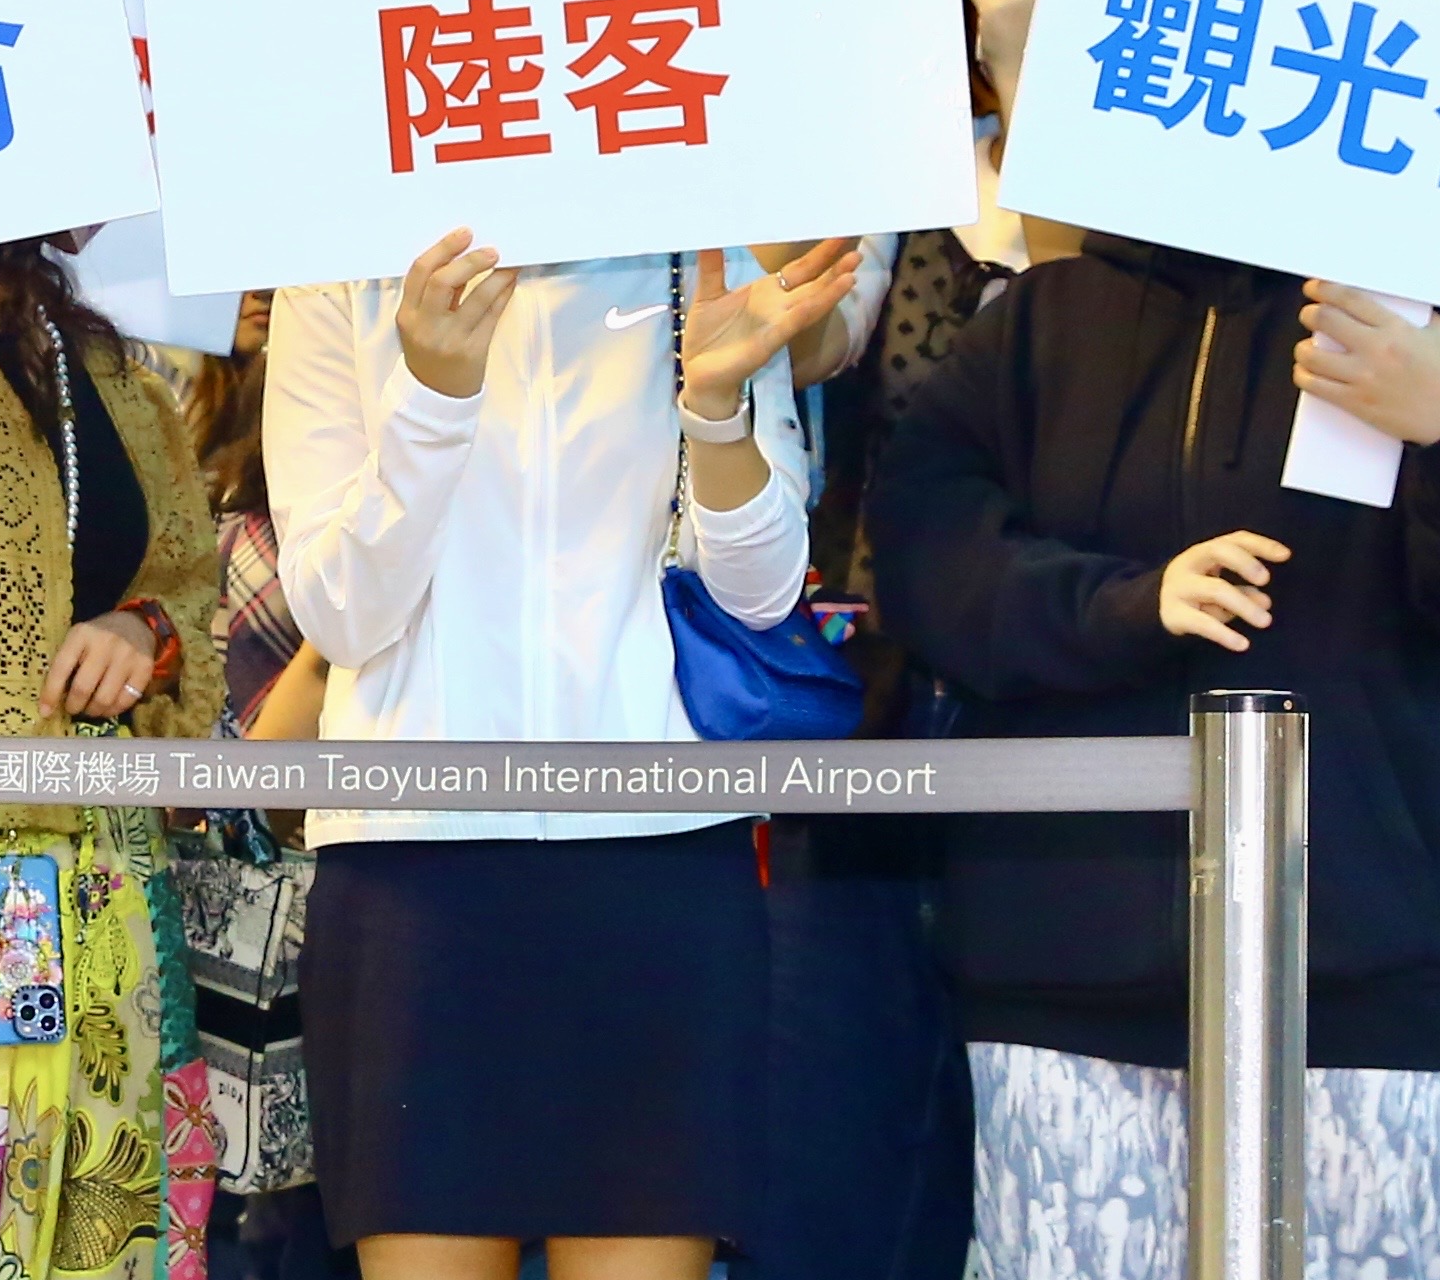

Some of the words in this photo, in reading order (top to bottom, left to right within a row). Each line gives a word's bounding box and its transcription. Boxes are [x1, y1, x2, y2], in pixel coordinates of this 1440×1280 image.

[170, 752, 306, 789] Taiwan
[319, 753, 488, 801] Taoyuan
[503, 756, 767, 795] International
[780, 757, 937, 805] Airport
